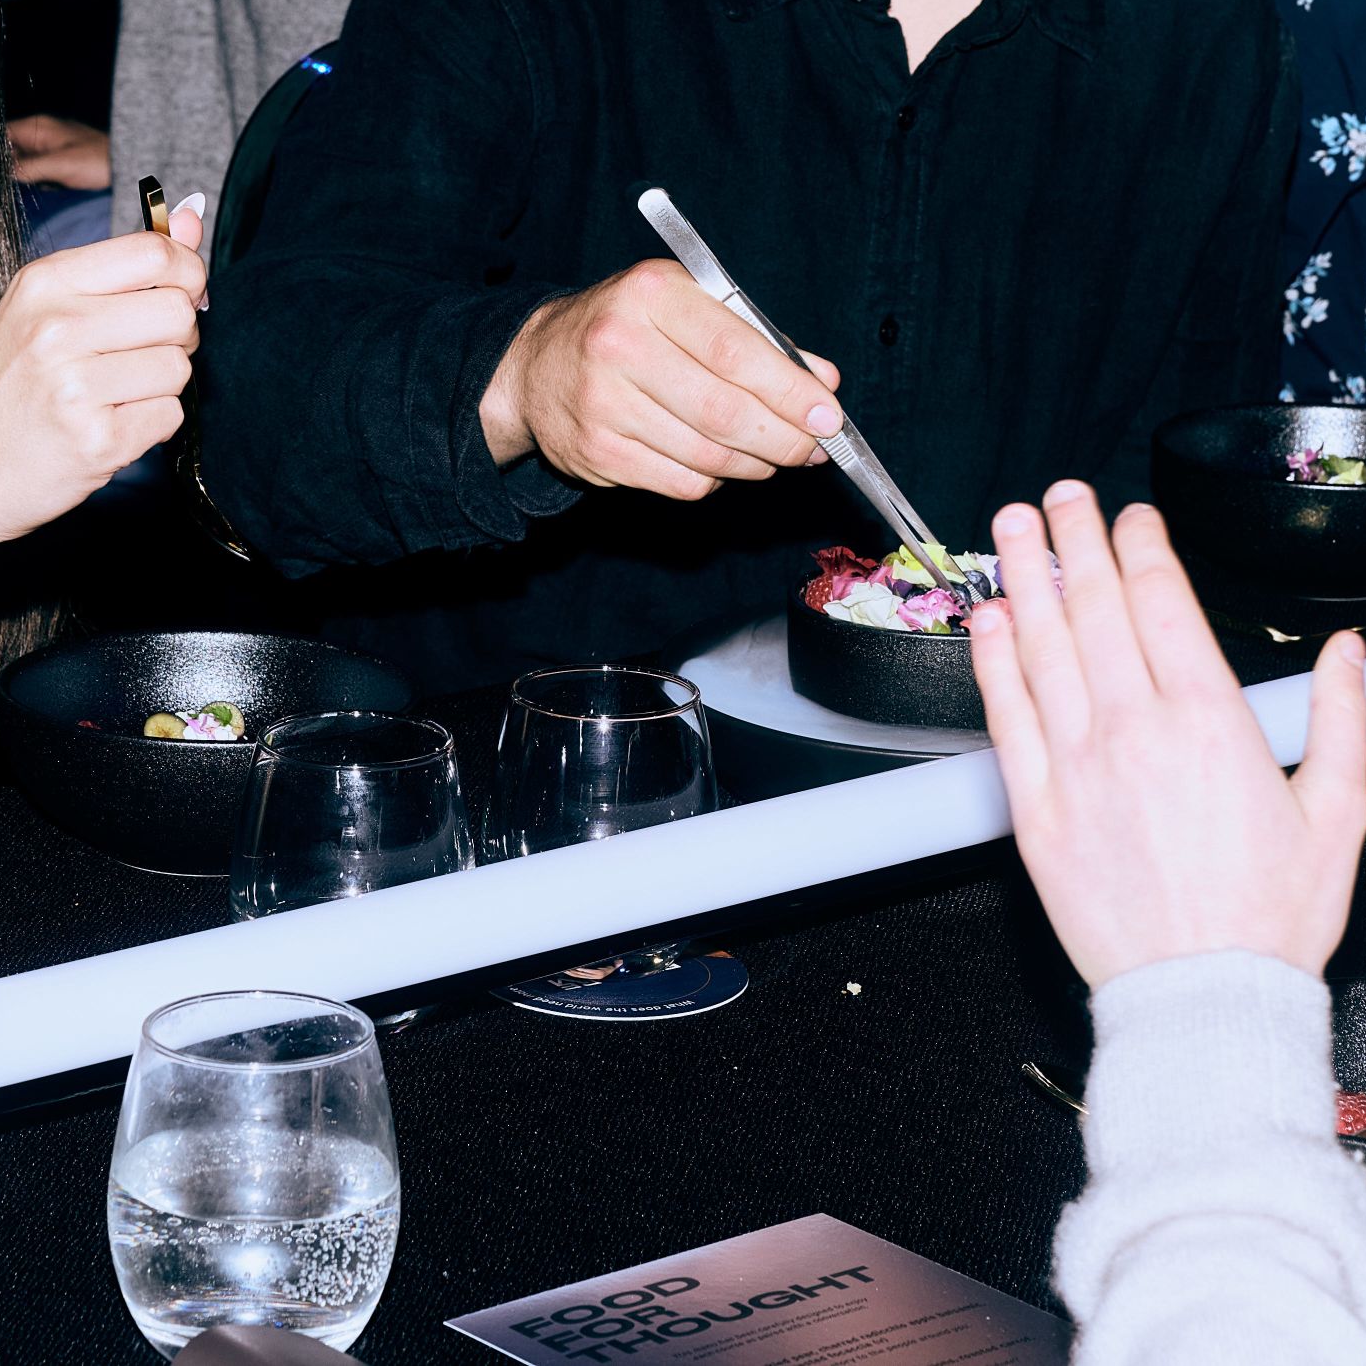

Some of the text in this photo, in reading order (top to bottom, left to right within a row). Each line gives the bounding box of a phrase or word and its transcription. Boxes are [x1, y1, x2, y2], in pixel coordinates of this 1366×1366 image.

[535, 995, 564, 1008] need
[564, 1001, 601, 1013] world
[665, 998, 696, 1010] What
[606, 1006, 628, 1014] the
[631, 1005, 662, 1014] does
[508, 1276, 701, 1339] FOOD
[565, 1265, 875, 1364] THOUGHT
[537, 1305, 680, 1354] FOR
